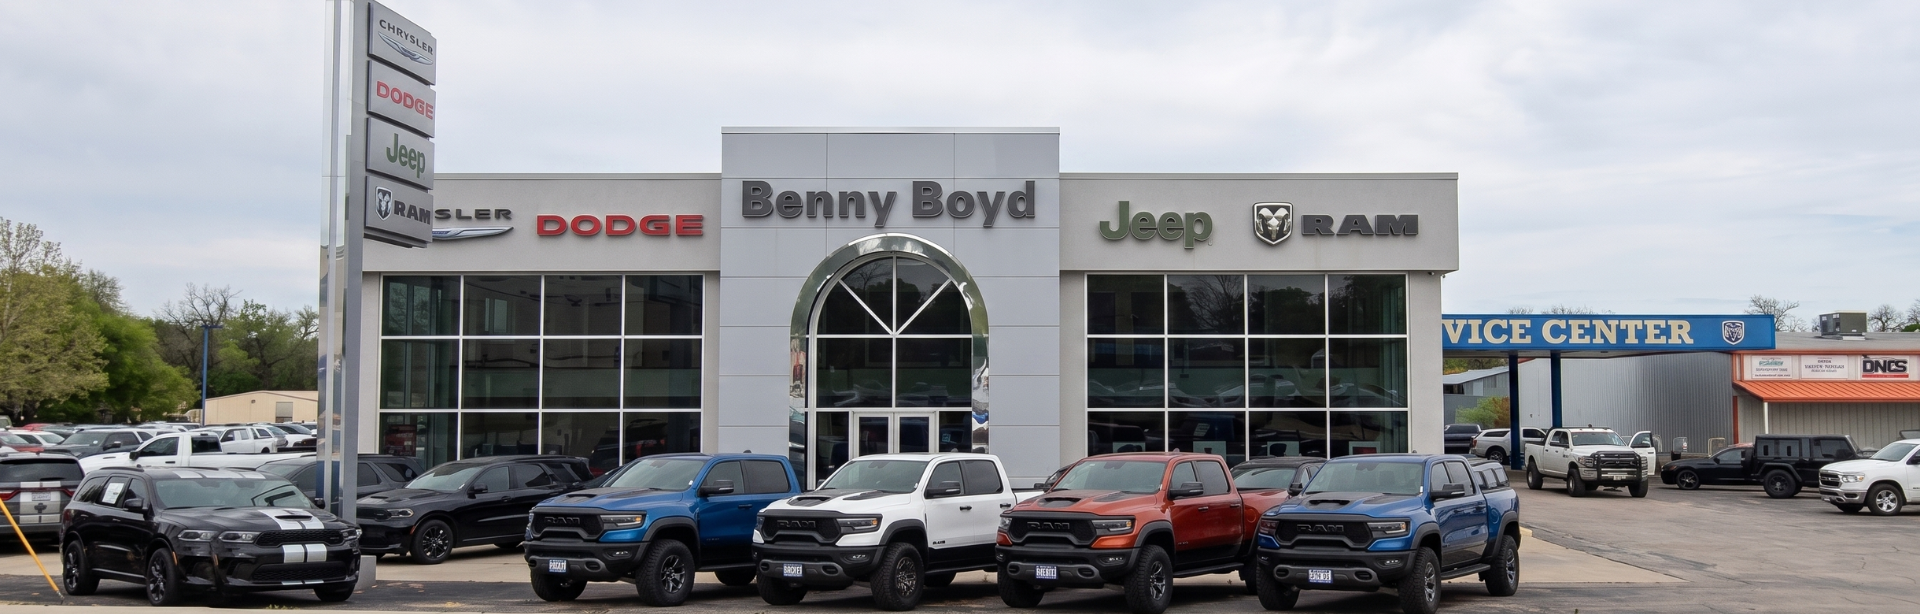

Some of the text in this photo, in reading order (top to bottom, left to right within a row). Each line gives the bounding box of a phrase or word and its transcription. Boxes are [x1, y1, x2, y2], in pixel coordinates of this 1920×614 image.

[379, 19, 433, 56] CHRYSLER
[376, 80, 434, 120] DODGE
[386, 132, 426, 179] Jeep
[393, 200, 431, 225] RAM
[434, 208, 513, 220] SLER
[741, 180, 1036, 228] Benny Boyd
[536, 213, 704, 237] DODGE
[1099, 200, 1213, 249] Jeep
[1300, 213, 1419, 236] RAM
[1441, 319, 1695, 344] VICE CENTER
[1296, 523, 1345, 532] RAM
